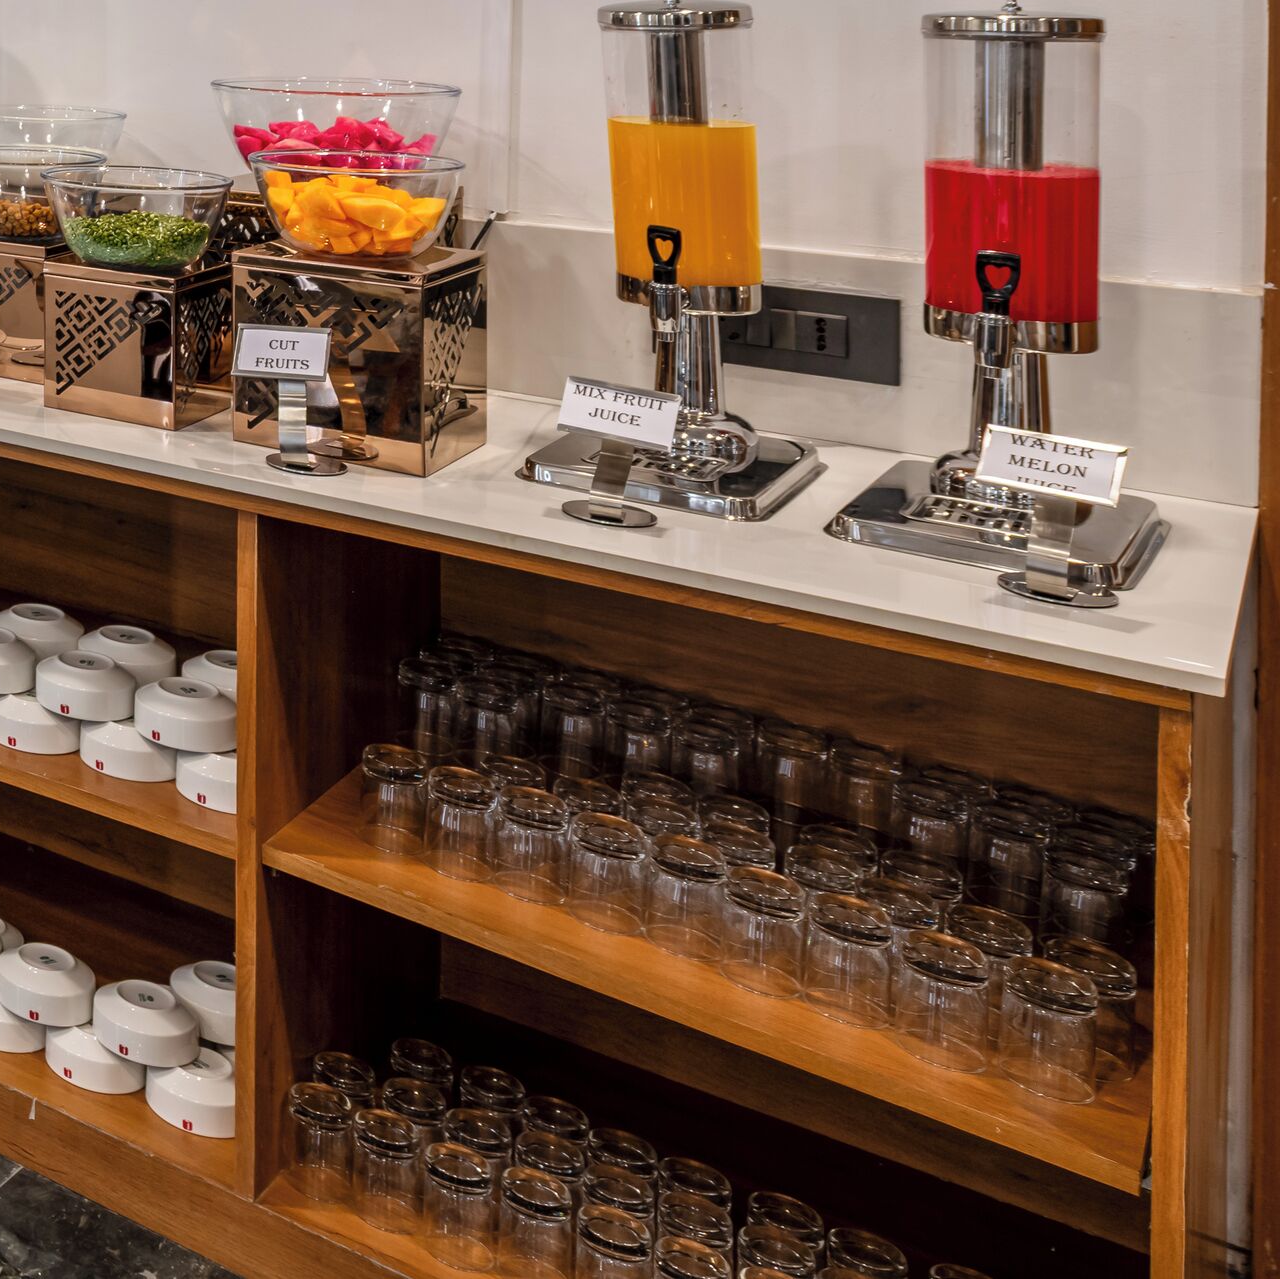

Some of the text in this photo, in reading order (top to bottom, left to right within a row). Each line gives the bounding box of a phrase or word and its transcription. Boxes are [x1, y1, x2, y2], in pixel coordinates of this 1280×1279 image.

[269, 339, 300, 351] CUT
[255, 357, 310, 370] FRUITS
[573, 384, 668, 411] MIX FRUIT
[588, 407, 641, 426] JUICE
[1010, 434, 1095, 459] WATER
[1008, 454, 1089, 478] MELON
